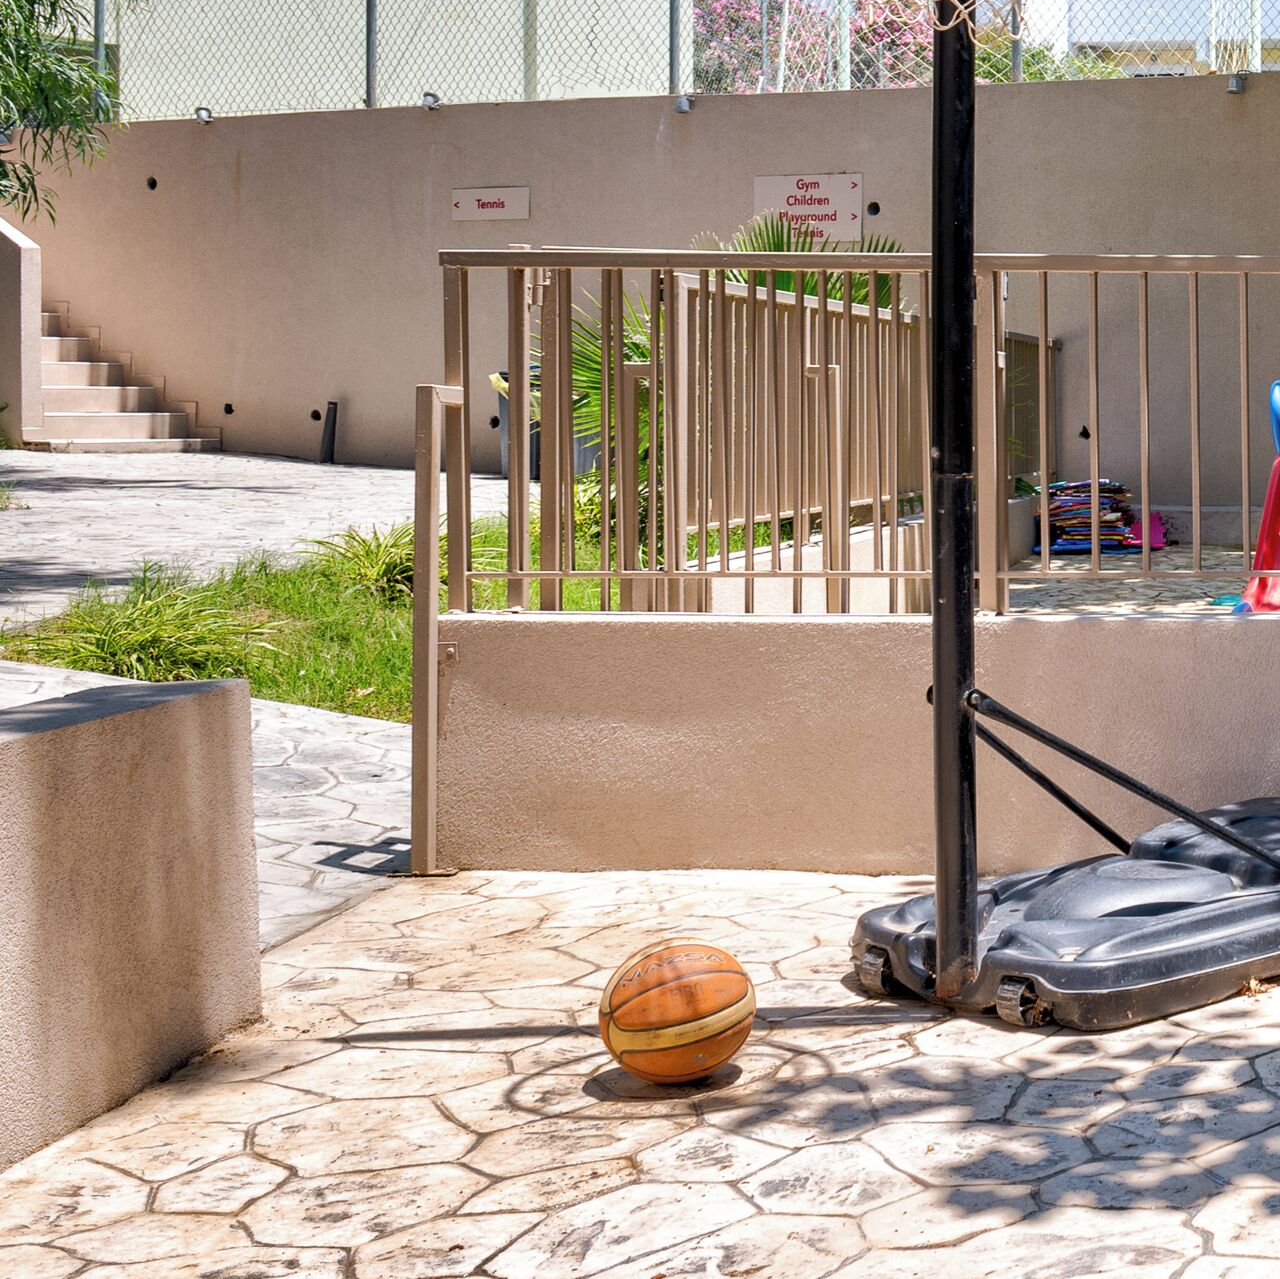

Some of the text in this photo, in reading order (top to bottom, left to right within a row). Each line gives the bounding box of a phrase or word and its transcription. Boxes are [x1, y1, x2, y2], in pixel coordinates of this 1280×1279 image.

[796, 179, 820, 192] Gym
[475, 198, 505, 209] Tennis
[786, 195, 830, 206] Children
[779, 210, 837, 225] Playground
